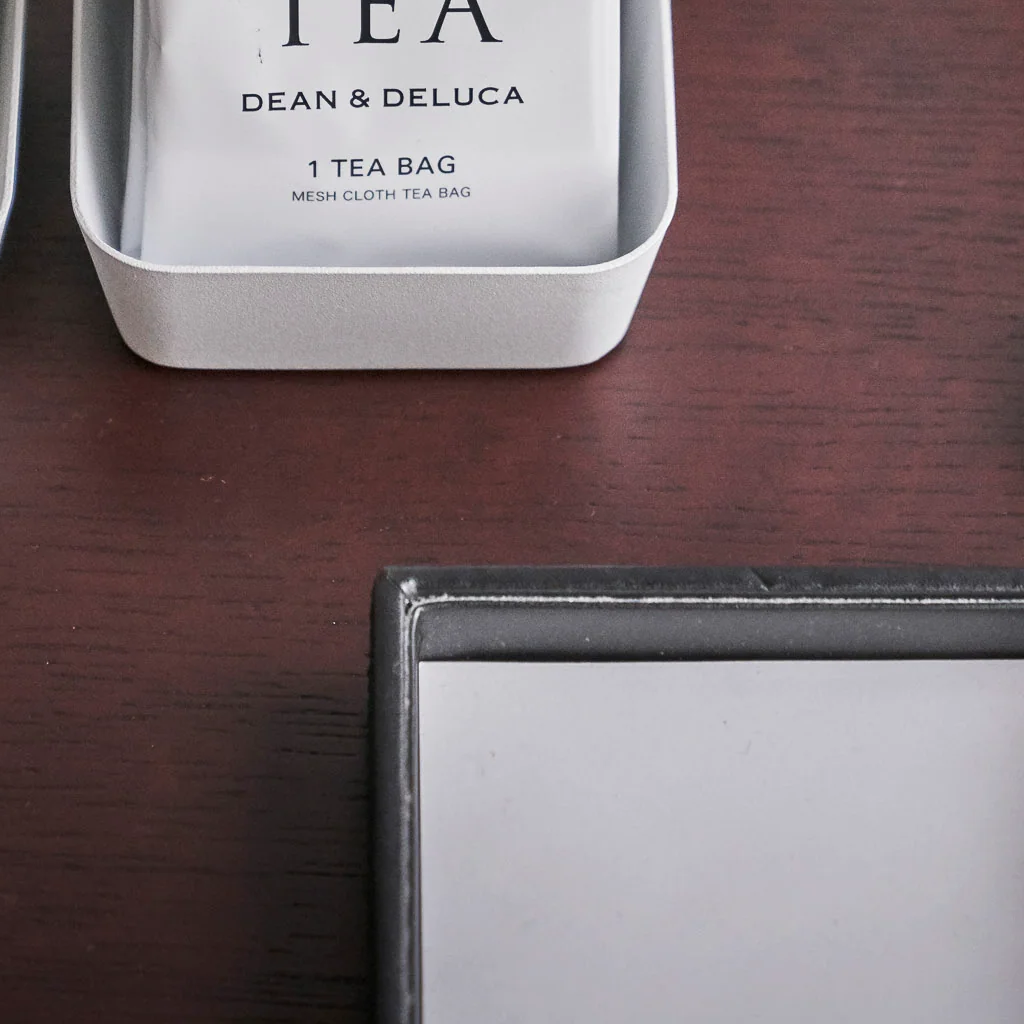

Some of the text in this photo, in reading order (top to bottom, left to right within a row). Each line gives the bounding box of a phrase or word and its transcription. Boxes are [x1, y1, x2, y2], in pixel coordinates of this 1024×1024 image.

[242, 86, 525, 112] DEAN & DELUCA
[308, 155, 456, 178] 1 TEA BAG
[291, 186, 471, 202] MESH CLOTH TEA BAG
